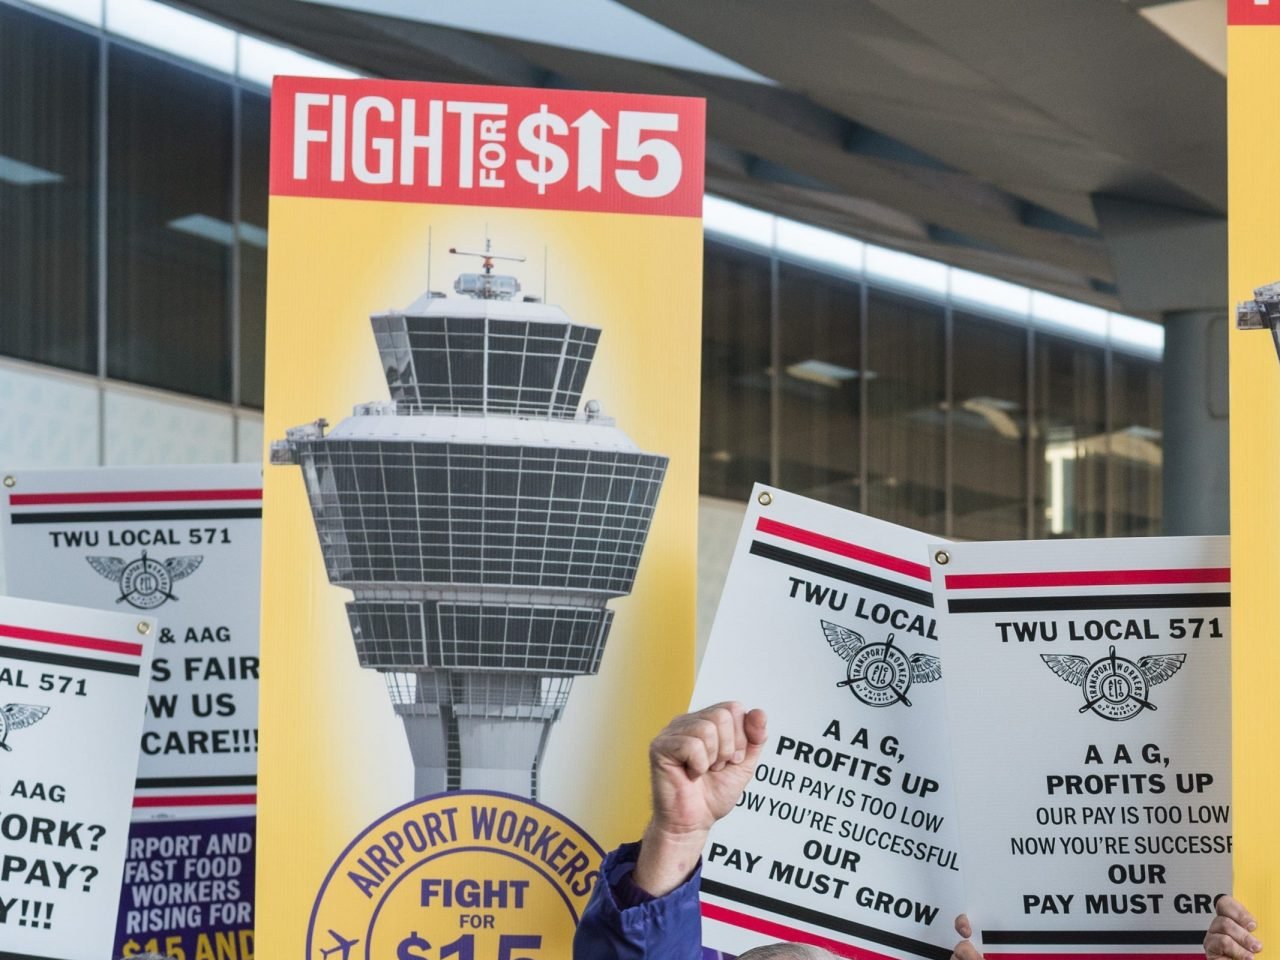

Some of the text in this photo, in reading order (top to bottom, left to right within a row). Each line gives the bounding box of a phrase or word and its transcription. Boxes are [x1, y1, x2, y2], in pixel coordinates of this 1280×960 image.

[293, 92, 683, 198] FIGHT FOR $15
[49, 528, 231, 548] TWU LOCAL 571
[788, 577, 939, 641] TWU LOCAL
[159, 626, 231, 644] & AAG
[995, 617, 1223, 643] TWU LOCAL 571
[185, 656, 259, 681] FAIR
[853, 648, 907, 690] TRANSPORT WORKERS
[1089, 662, 1143, 699] TRANSPORT WORKERS
[39, 674, 88, 697] 571
[192, 693, 236, 717] US
[775, 736, 940, 800] PROFITS UP
[10, 779, 66, 804] AAG
[1047, 772, 1214, 796] PROFITS UP
[755, 764, 944, 834] OUR PAY IS TOO LOW
[1036, 804, 1230, 826] OUR PAY IS TOO LOW
[0, 812, 107, 852] ORK?
[206, 832, 253, 855] AND
[769, 799, 837, 834] YOU'RE
[839, 821, 960, 872] SUCCESSFUL
[1011, 836, 1056, 855] NOW
[1059, 836, 1130, 855] YOU'RE
[347, 806, 600, 899] AIRPORT WORKERS
[803, 839, 861, 873] OUR
[1, 855, 99, 893] PAY?
[124, 856, 243, 884] FAST FOOD
[708, 842, 940, 926] PAY MUST GROW
[1107, 864, 1167, 885] OUR
[132, 879, 241, 909] WORKERS
[420, 879, 530, 909] FIGHT
[1023, 894, 1164, 915] PAY MUST
[126, 902, 251, 935] RISING FOR
[459, 914, 495, 929] FOR
